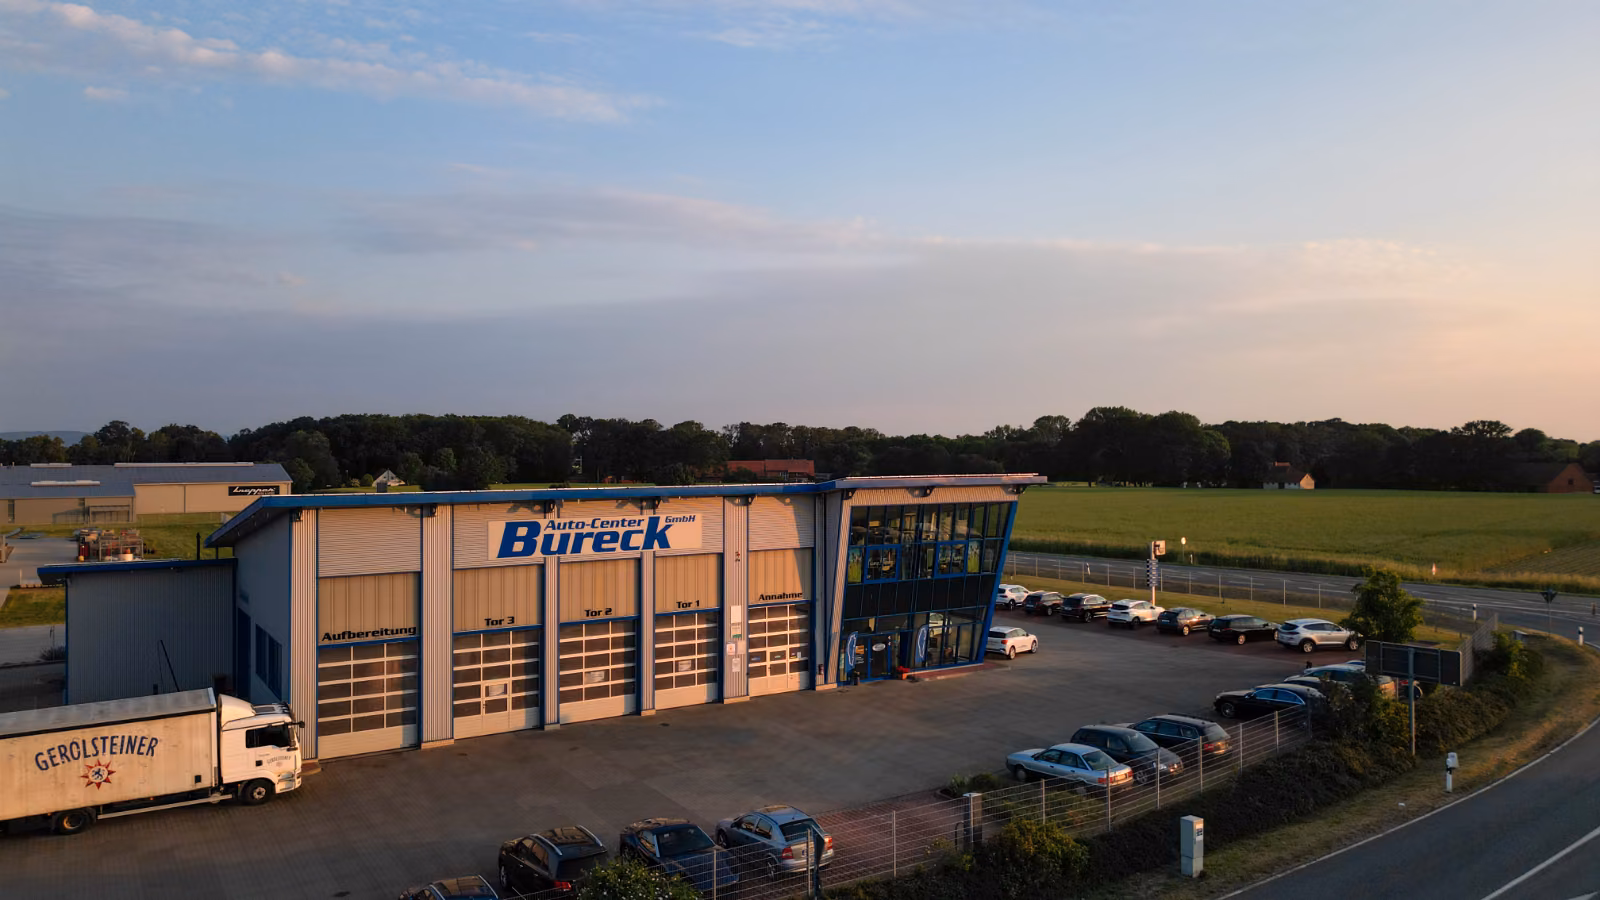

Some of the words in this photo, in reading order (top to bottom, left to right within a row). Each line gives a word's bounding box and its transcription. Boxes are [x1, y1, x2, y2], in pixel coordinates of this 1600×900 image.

[544, 518, 645, 531] Auto-Center
[664, 515, 696, 524] GmbH
[496, 516, 672, 558] Bureck
[758, 592, 803, 601] Annahme
[676, 601, 693, 609] Tor
[584, 609, 603, 617] Tor
[604, 608, 612, 616] 2
[484, 618, 505, 627] Tor
[507, 616, 515, 625] 3
[321, 626, 416, 641] Aufbereitung
[34, 735, 159, 771] GEROLSTEINER
